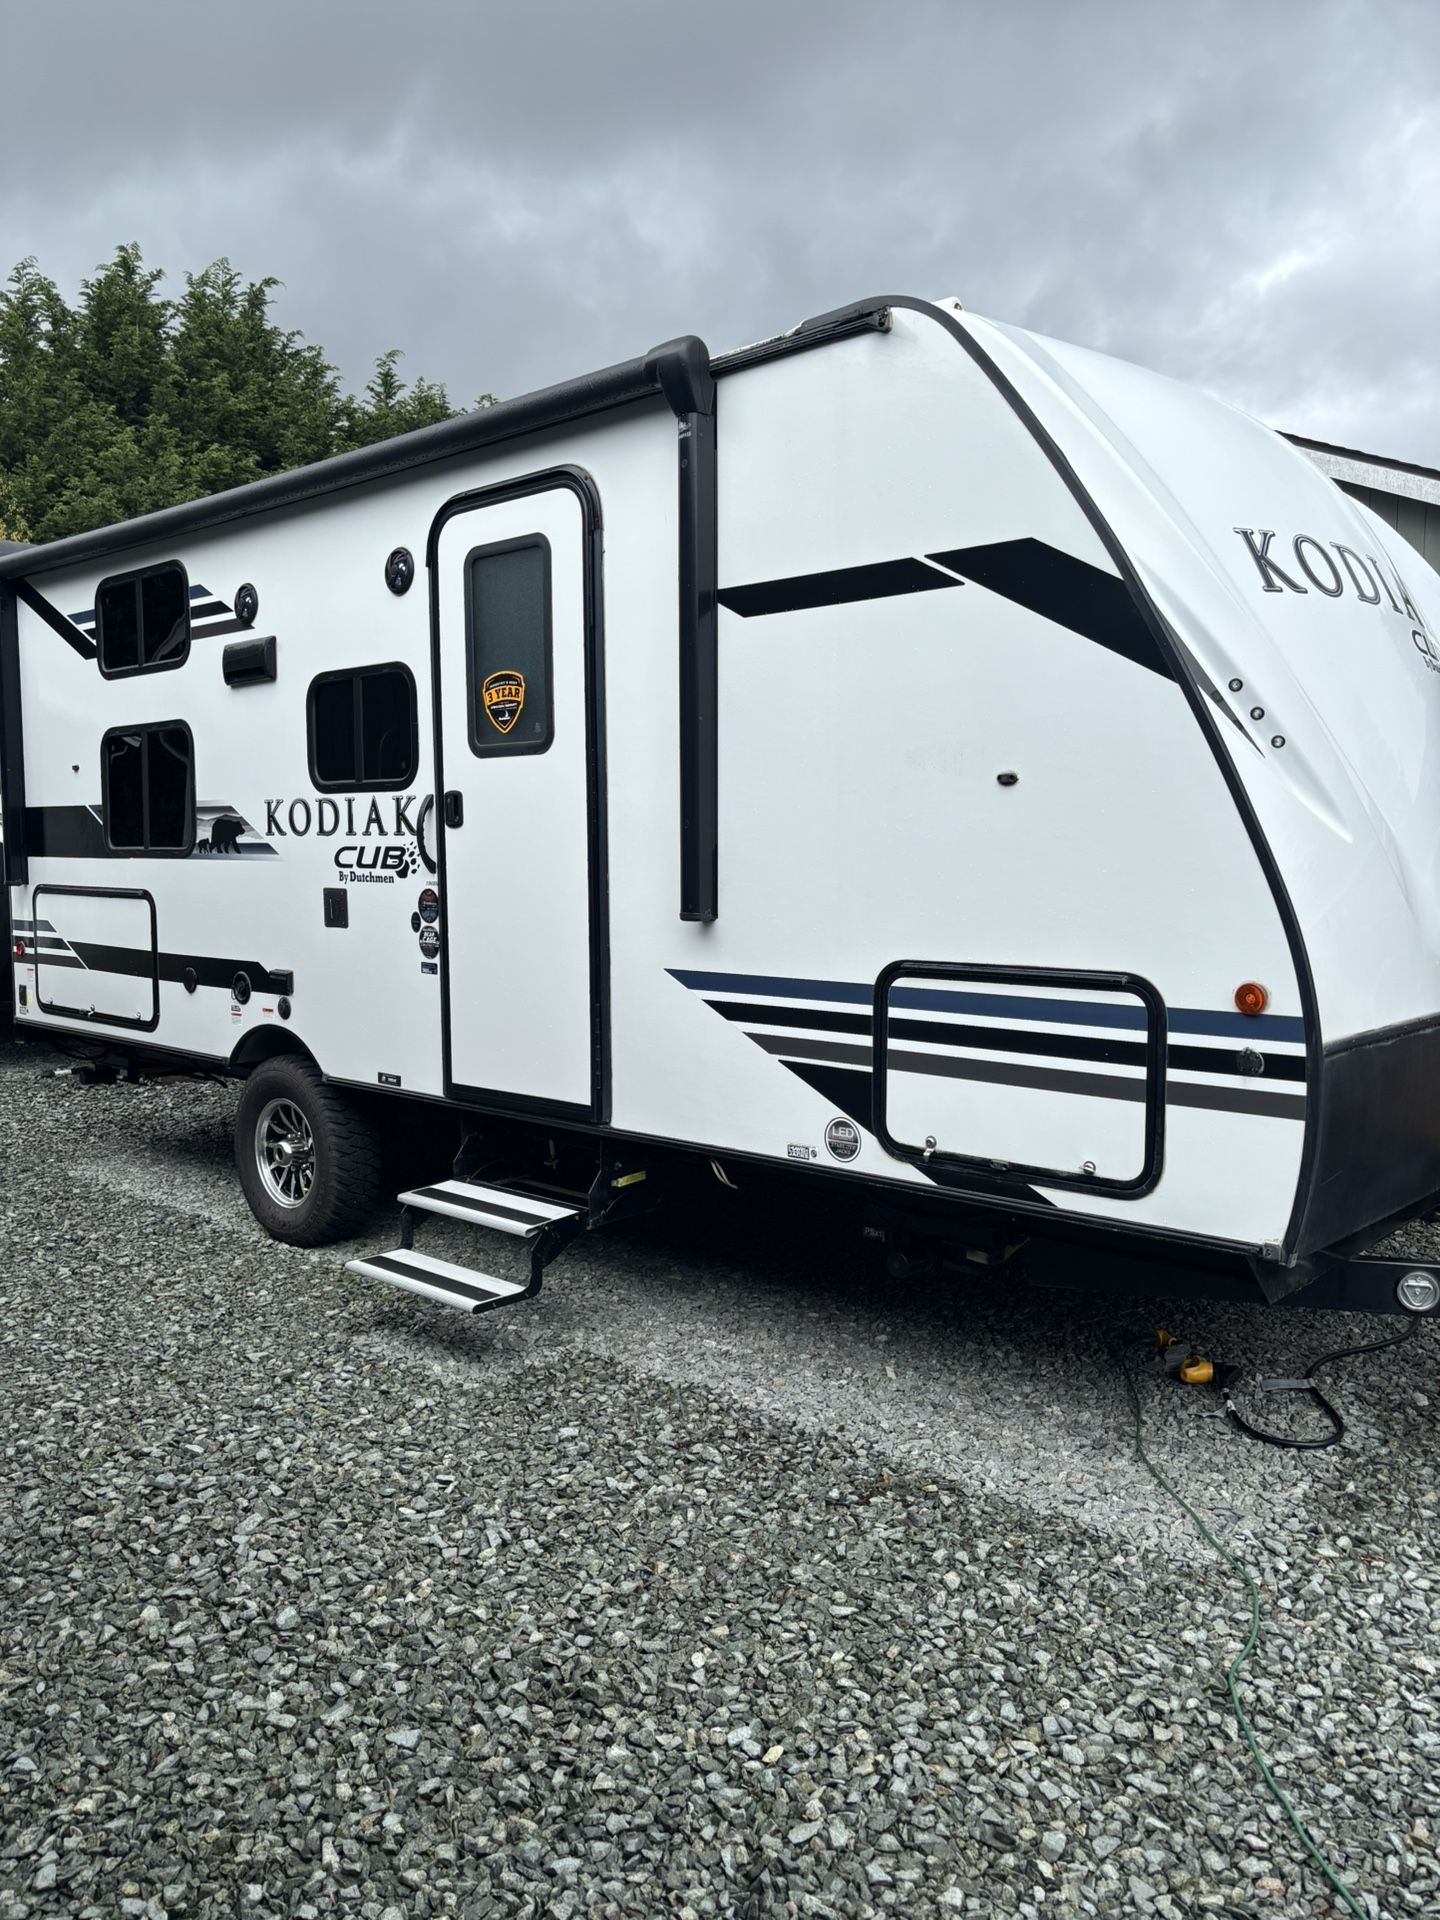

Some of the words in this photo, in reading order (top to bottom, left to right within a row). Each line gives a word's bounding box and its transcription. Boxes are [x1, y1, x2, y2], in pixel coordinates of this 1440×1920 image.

[1233, 527, 1425, 628] KODIA
[486, 691, 494, 703] 3
[494, 686, 520, 700] YEAR
[264, 795, 418, 837] KODIAK
[334, 845, 407, 870] CUB
[338, 871, 349, 885] By
[349, 870, 395, 885] Dutchmen
[832, 1125, 855, 1138] LED
